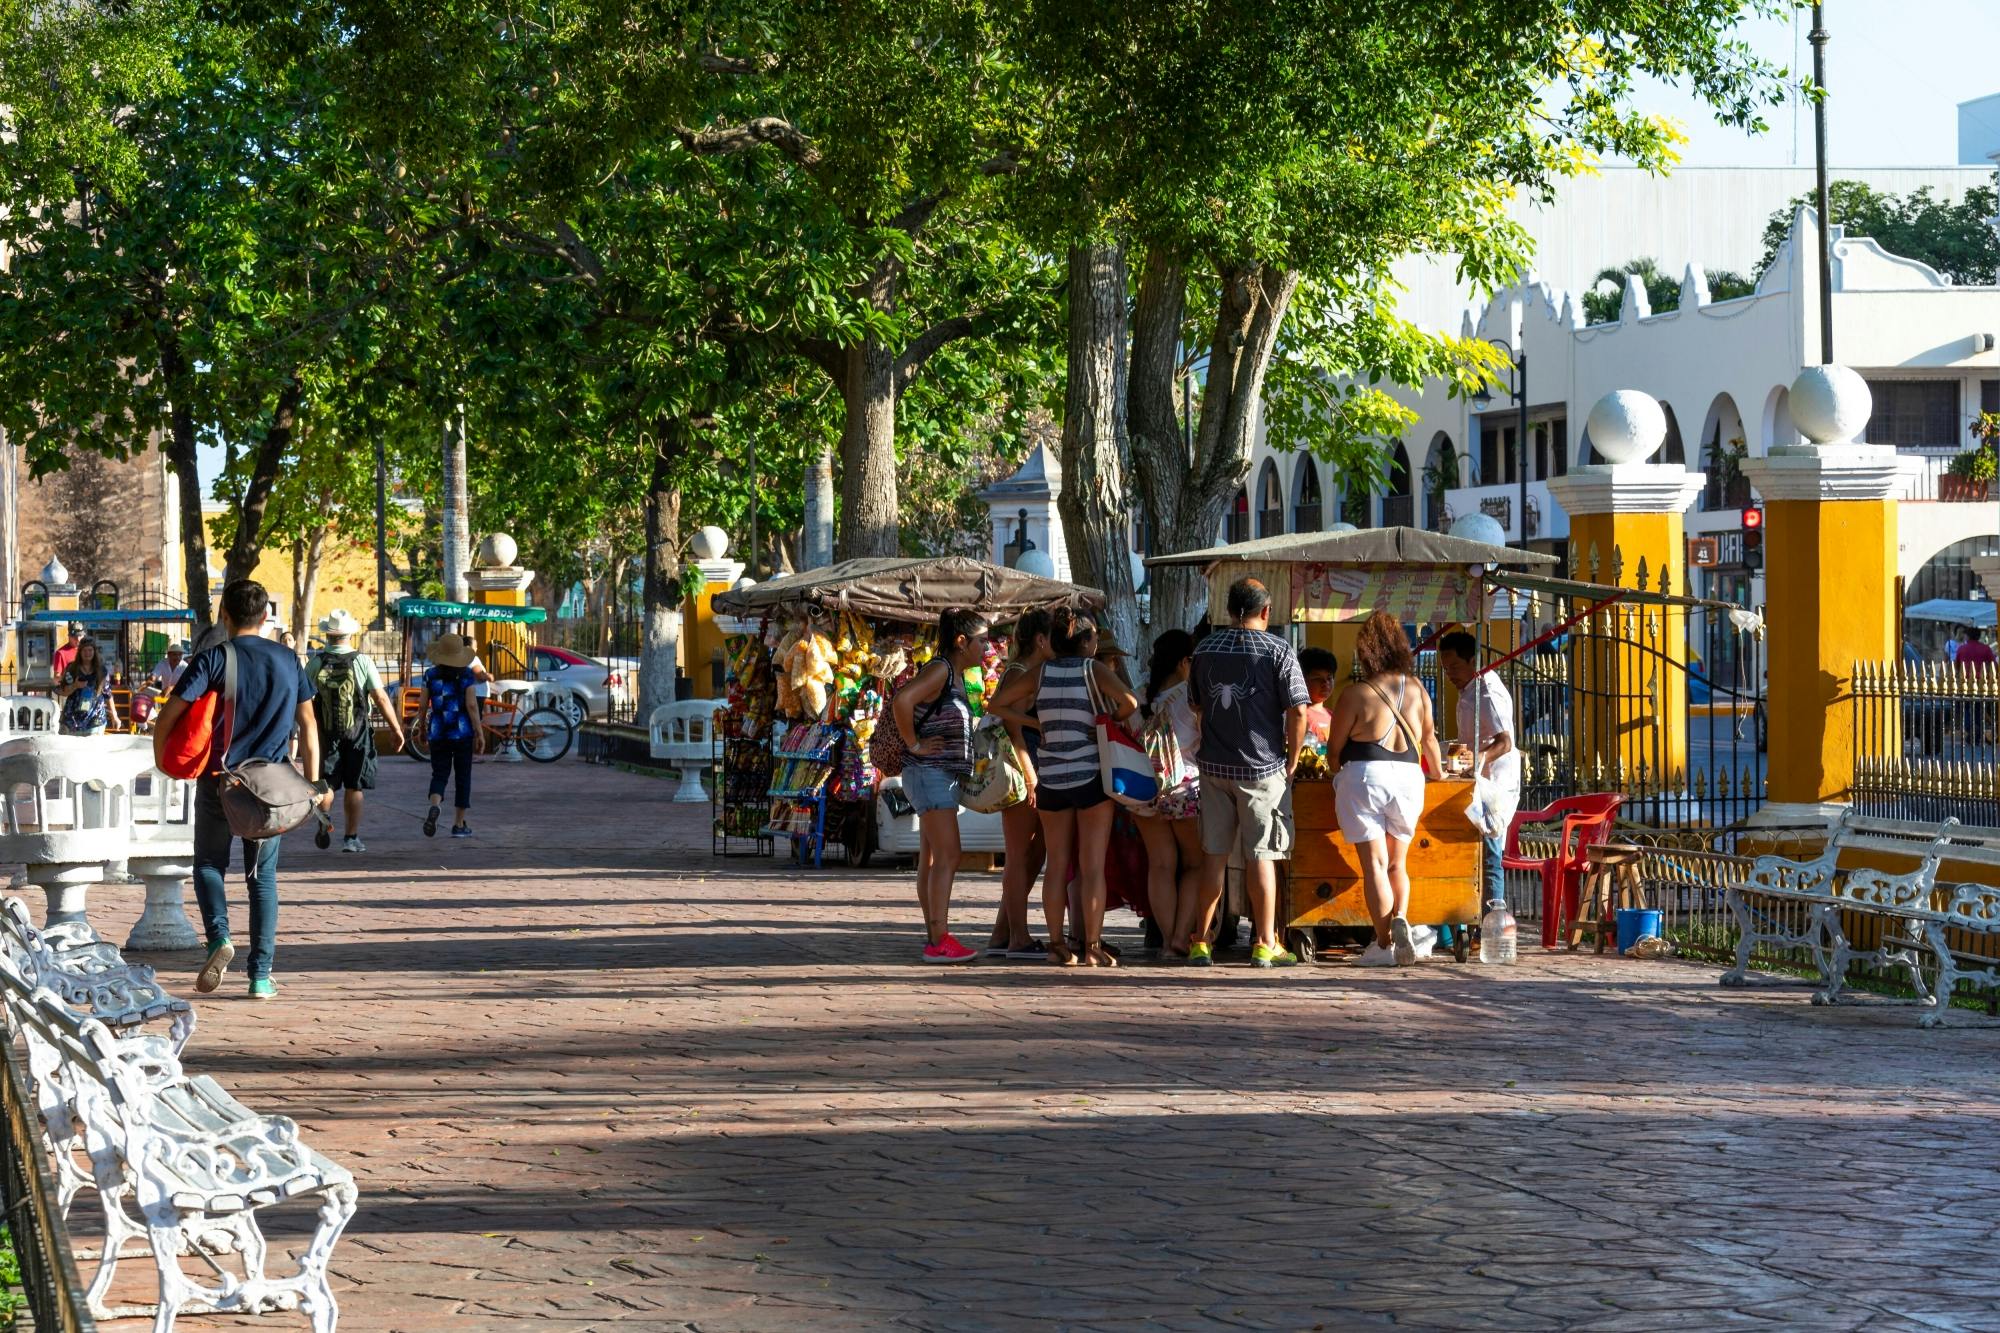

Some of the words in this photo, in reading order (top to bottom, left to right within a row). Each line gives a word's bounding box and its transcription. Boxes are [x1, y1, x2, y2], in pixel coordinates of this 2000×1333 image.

[1697, 549, 1708, 559] 41
[406, 604, 426, 615] ICE
[429, 605, 462, 616] CREAM
[468, 607, 514, 619] HELADOS
